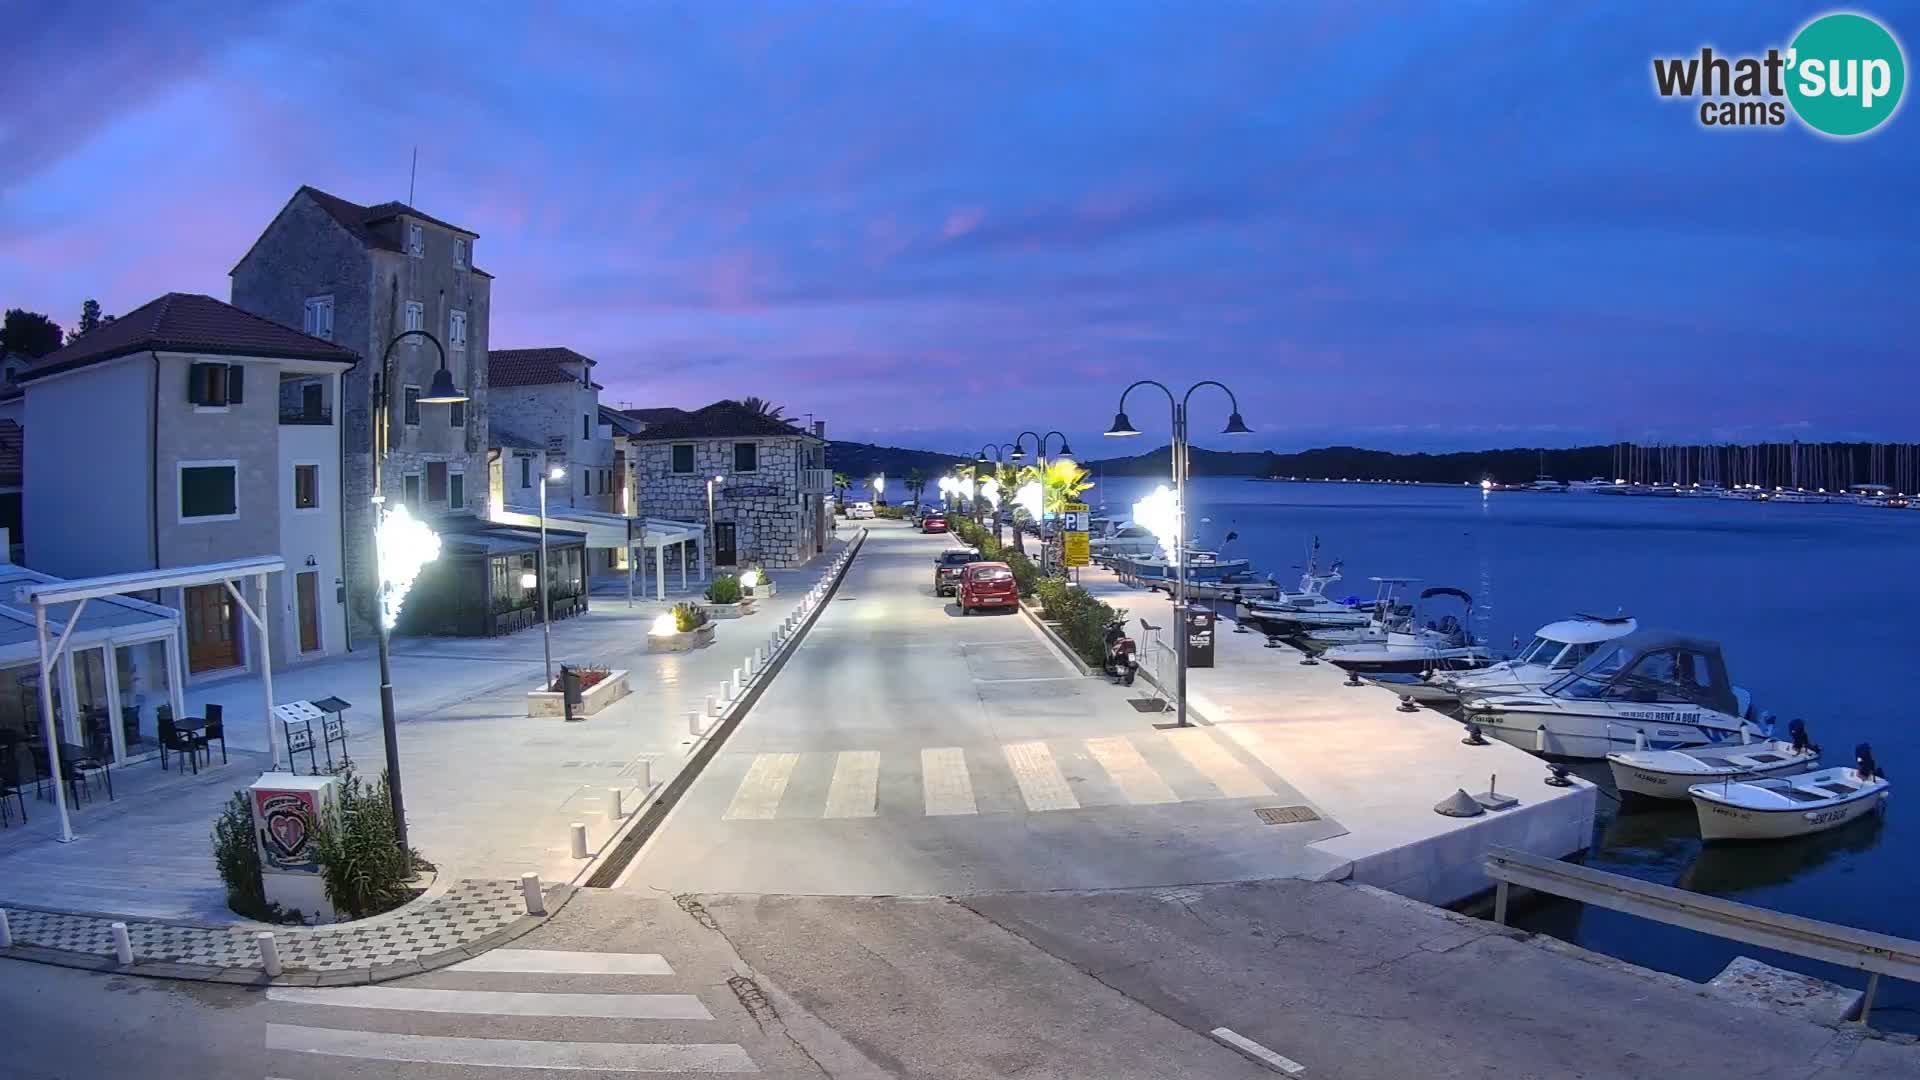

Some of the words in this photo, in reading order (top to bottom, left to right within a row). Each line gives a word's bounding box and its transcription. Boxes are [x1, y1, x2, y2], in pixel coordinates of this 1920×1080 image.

[1655, 712, 1675, 721] RENT
[1675, 712, 1681, 722] A
[1682, 712, 1701, 724] BOAT
